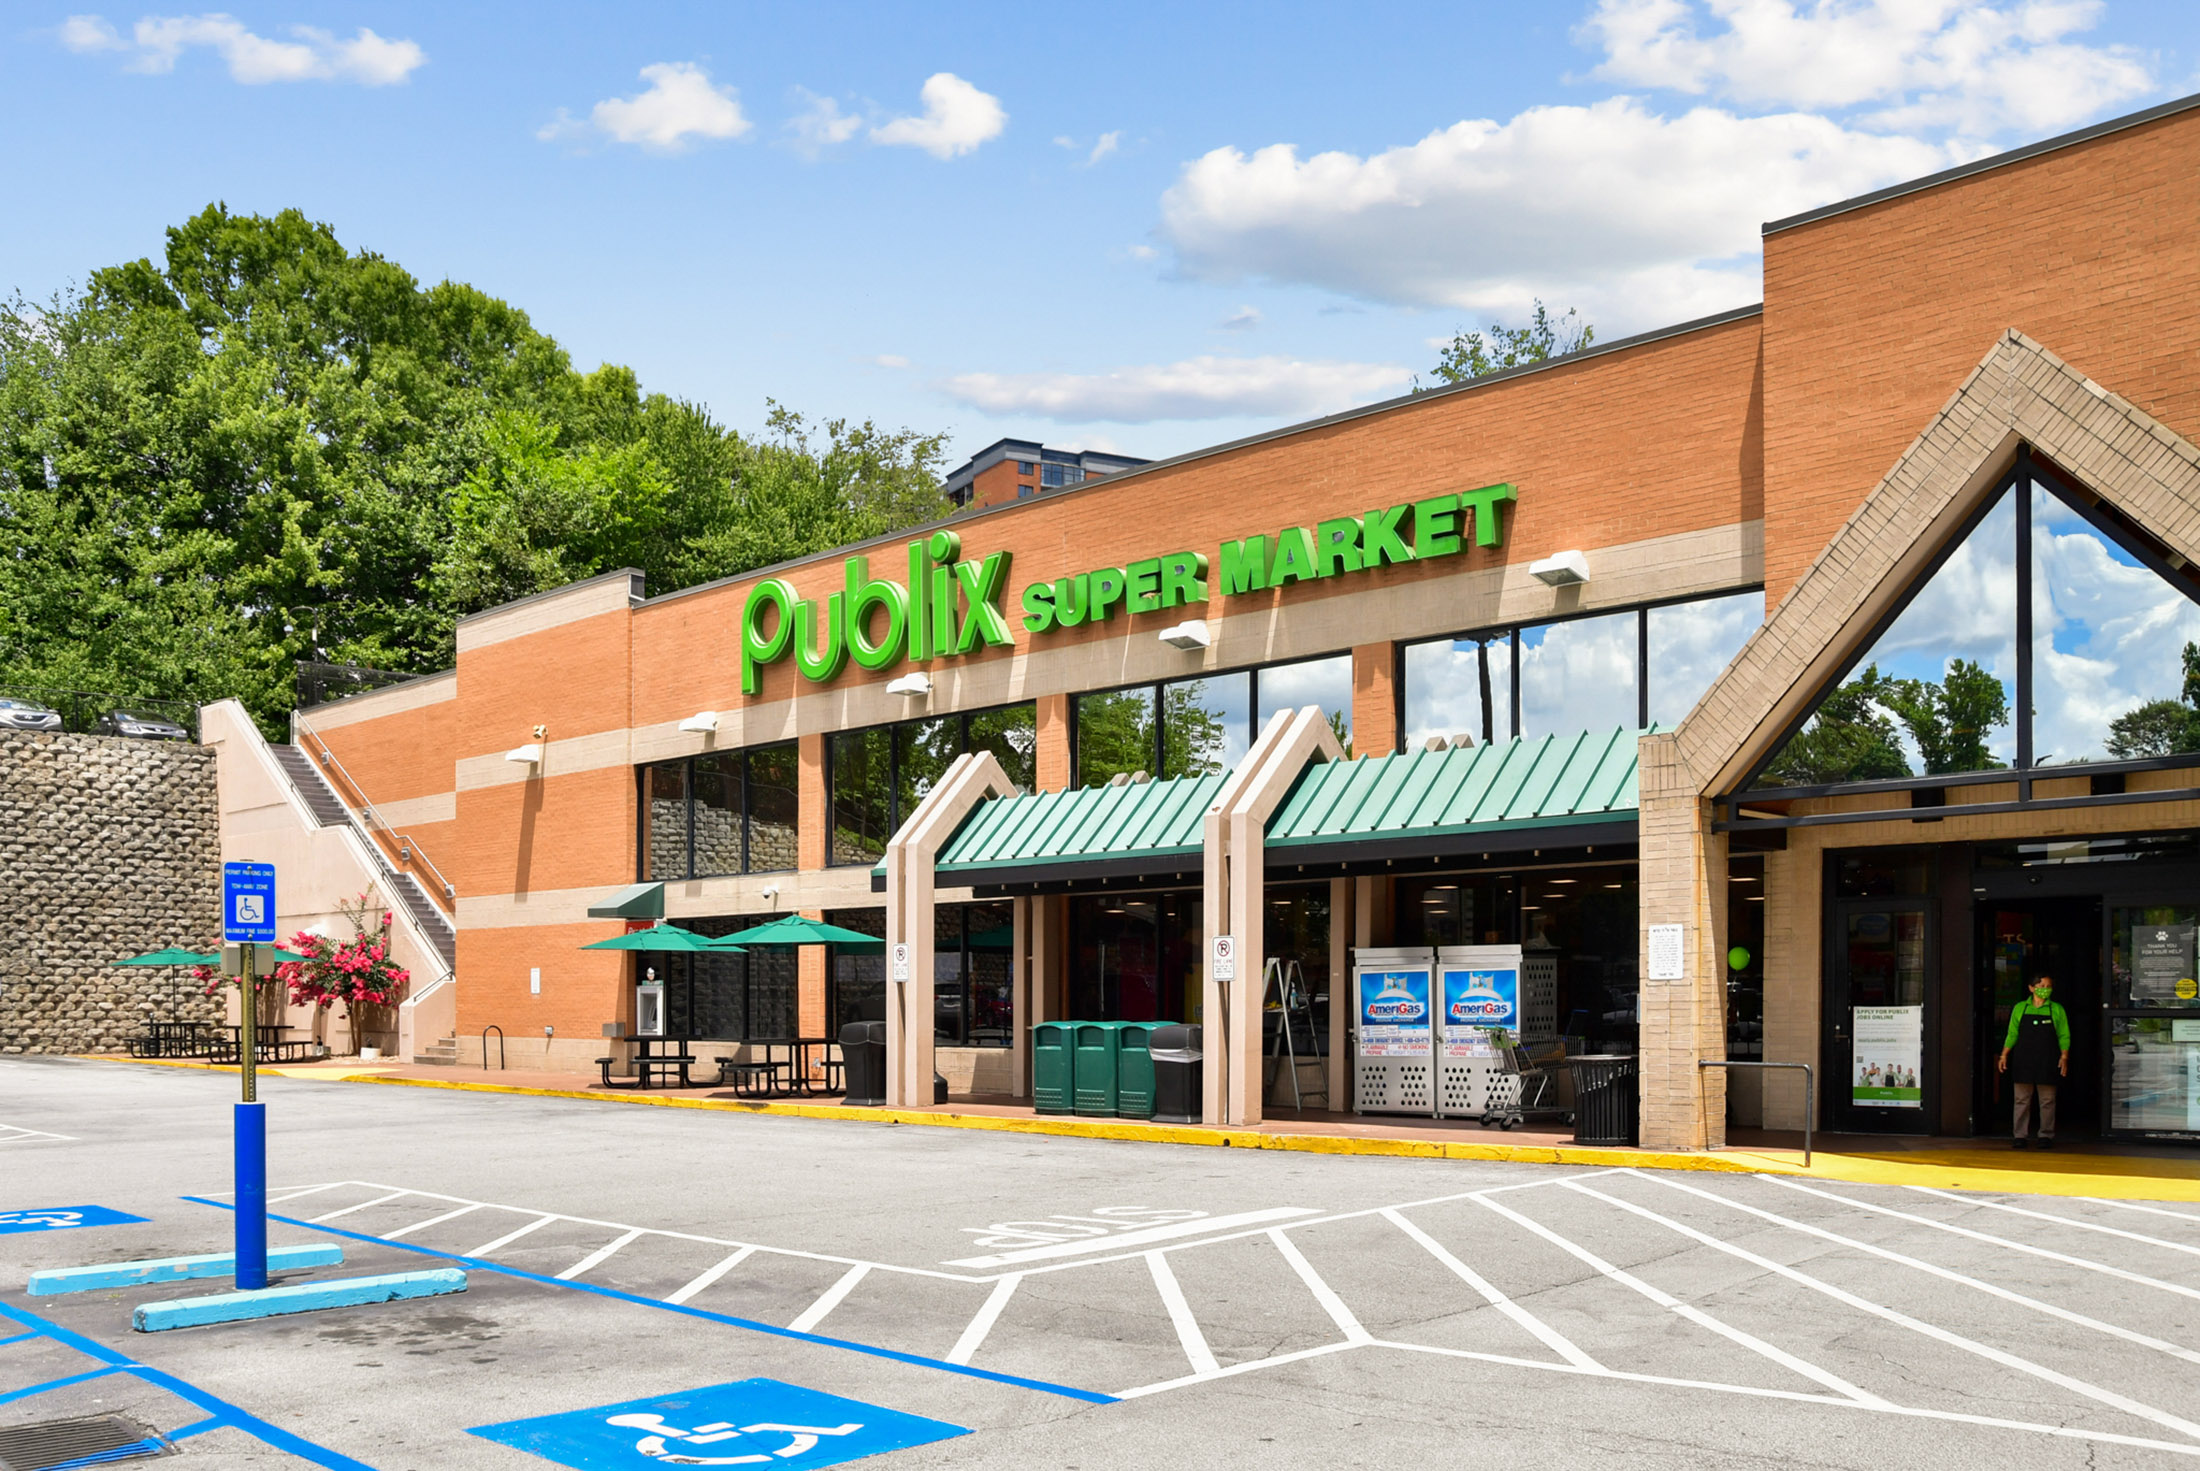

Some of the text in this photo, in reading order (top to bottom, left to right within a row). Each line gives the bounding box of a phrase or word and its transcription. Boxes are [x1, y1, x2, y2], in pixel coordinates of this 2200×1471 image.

[741, 482, 1518, 696] Publix SUPER MARKET
[1368, 1003, 1421, 1014] AmeriGas
[1452, 1002, 1508, 1014] AmeriGas
